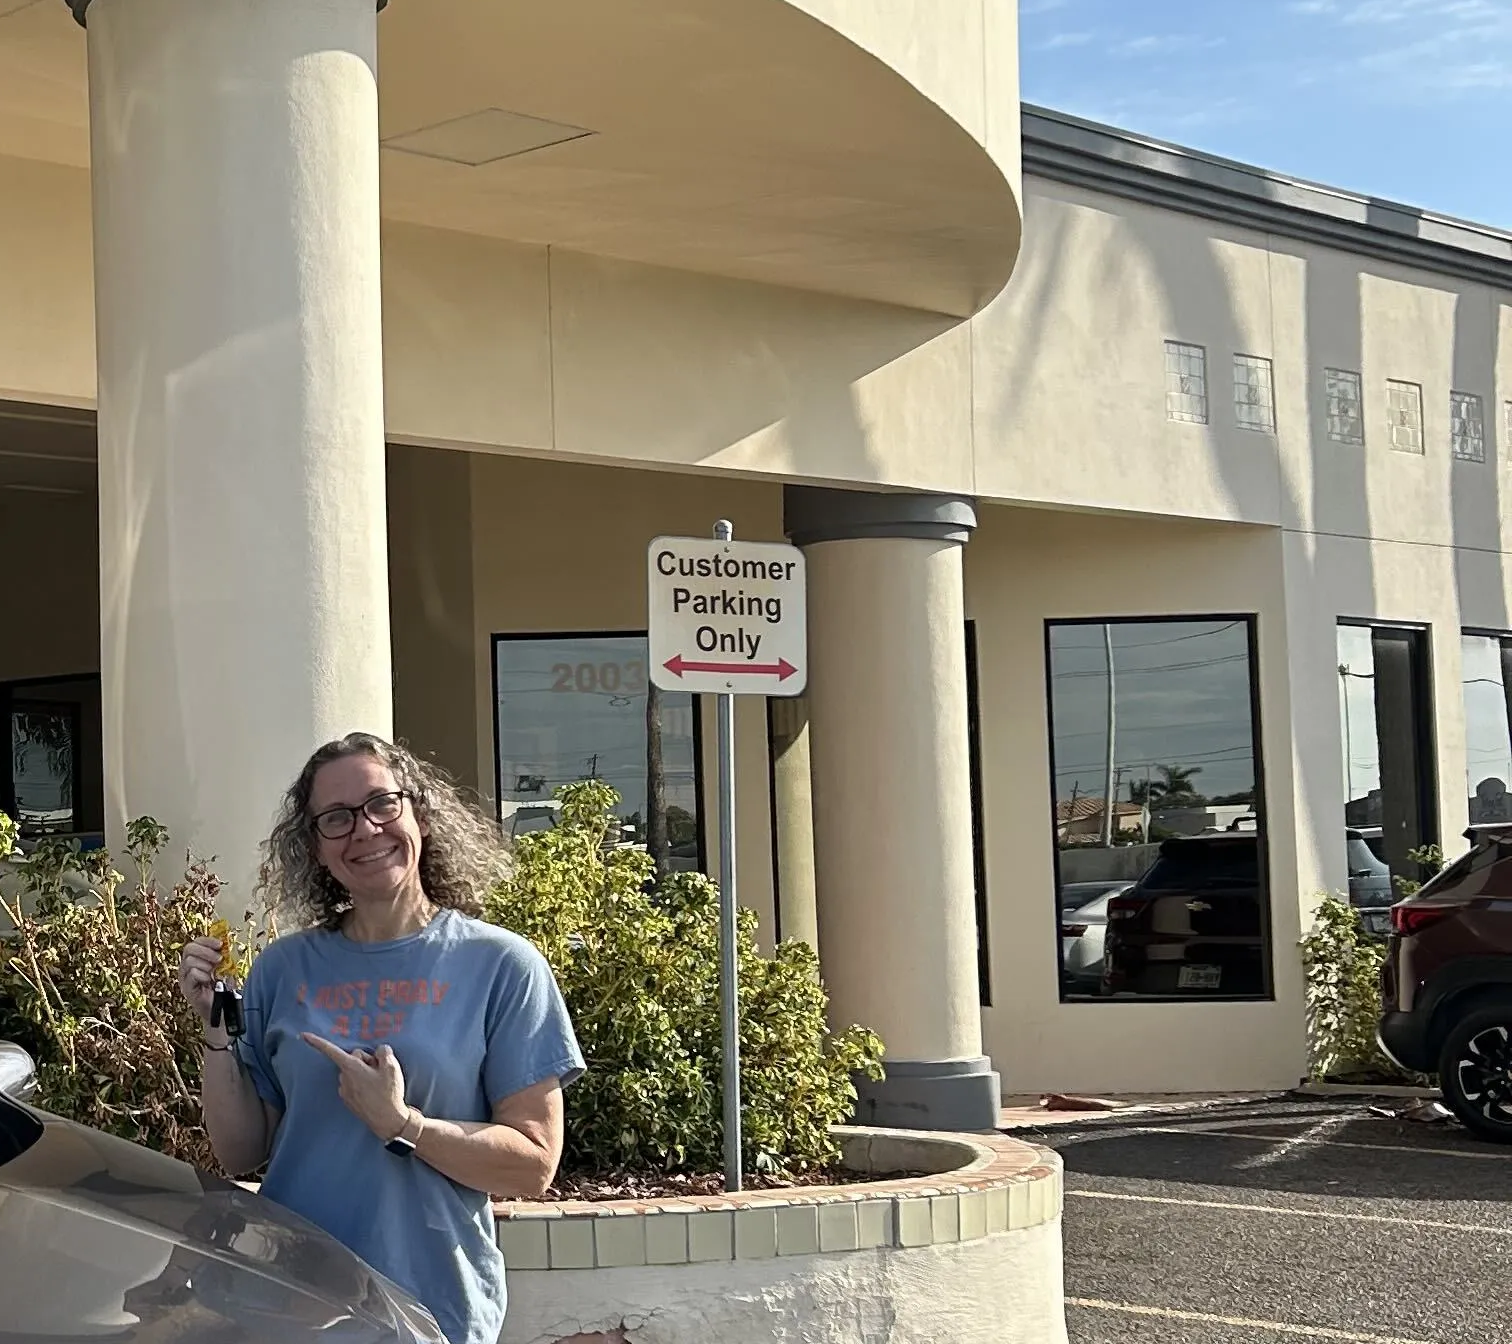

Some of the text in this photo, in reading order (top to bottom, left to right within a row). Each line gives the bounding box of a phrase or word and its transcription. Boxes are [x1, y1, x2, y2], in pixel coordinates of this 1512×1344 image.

[656, 551, 796, 581] Customer
[673, 588, 782, 624] Parking
[696, 626, 762, 660] Only
[551, 662, 647, 694] 2003
[377, 977, 450, 1007] PRAY
